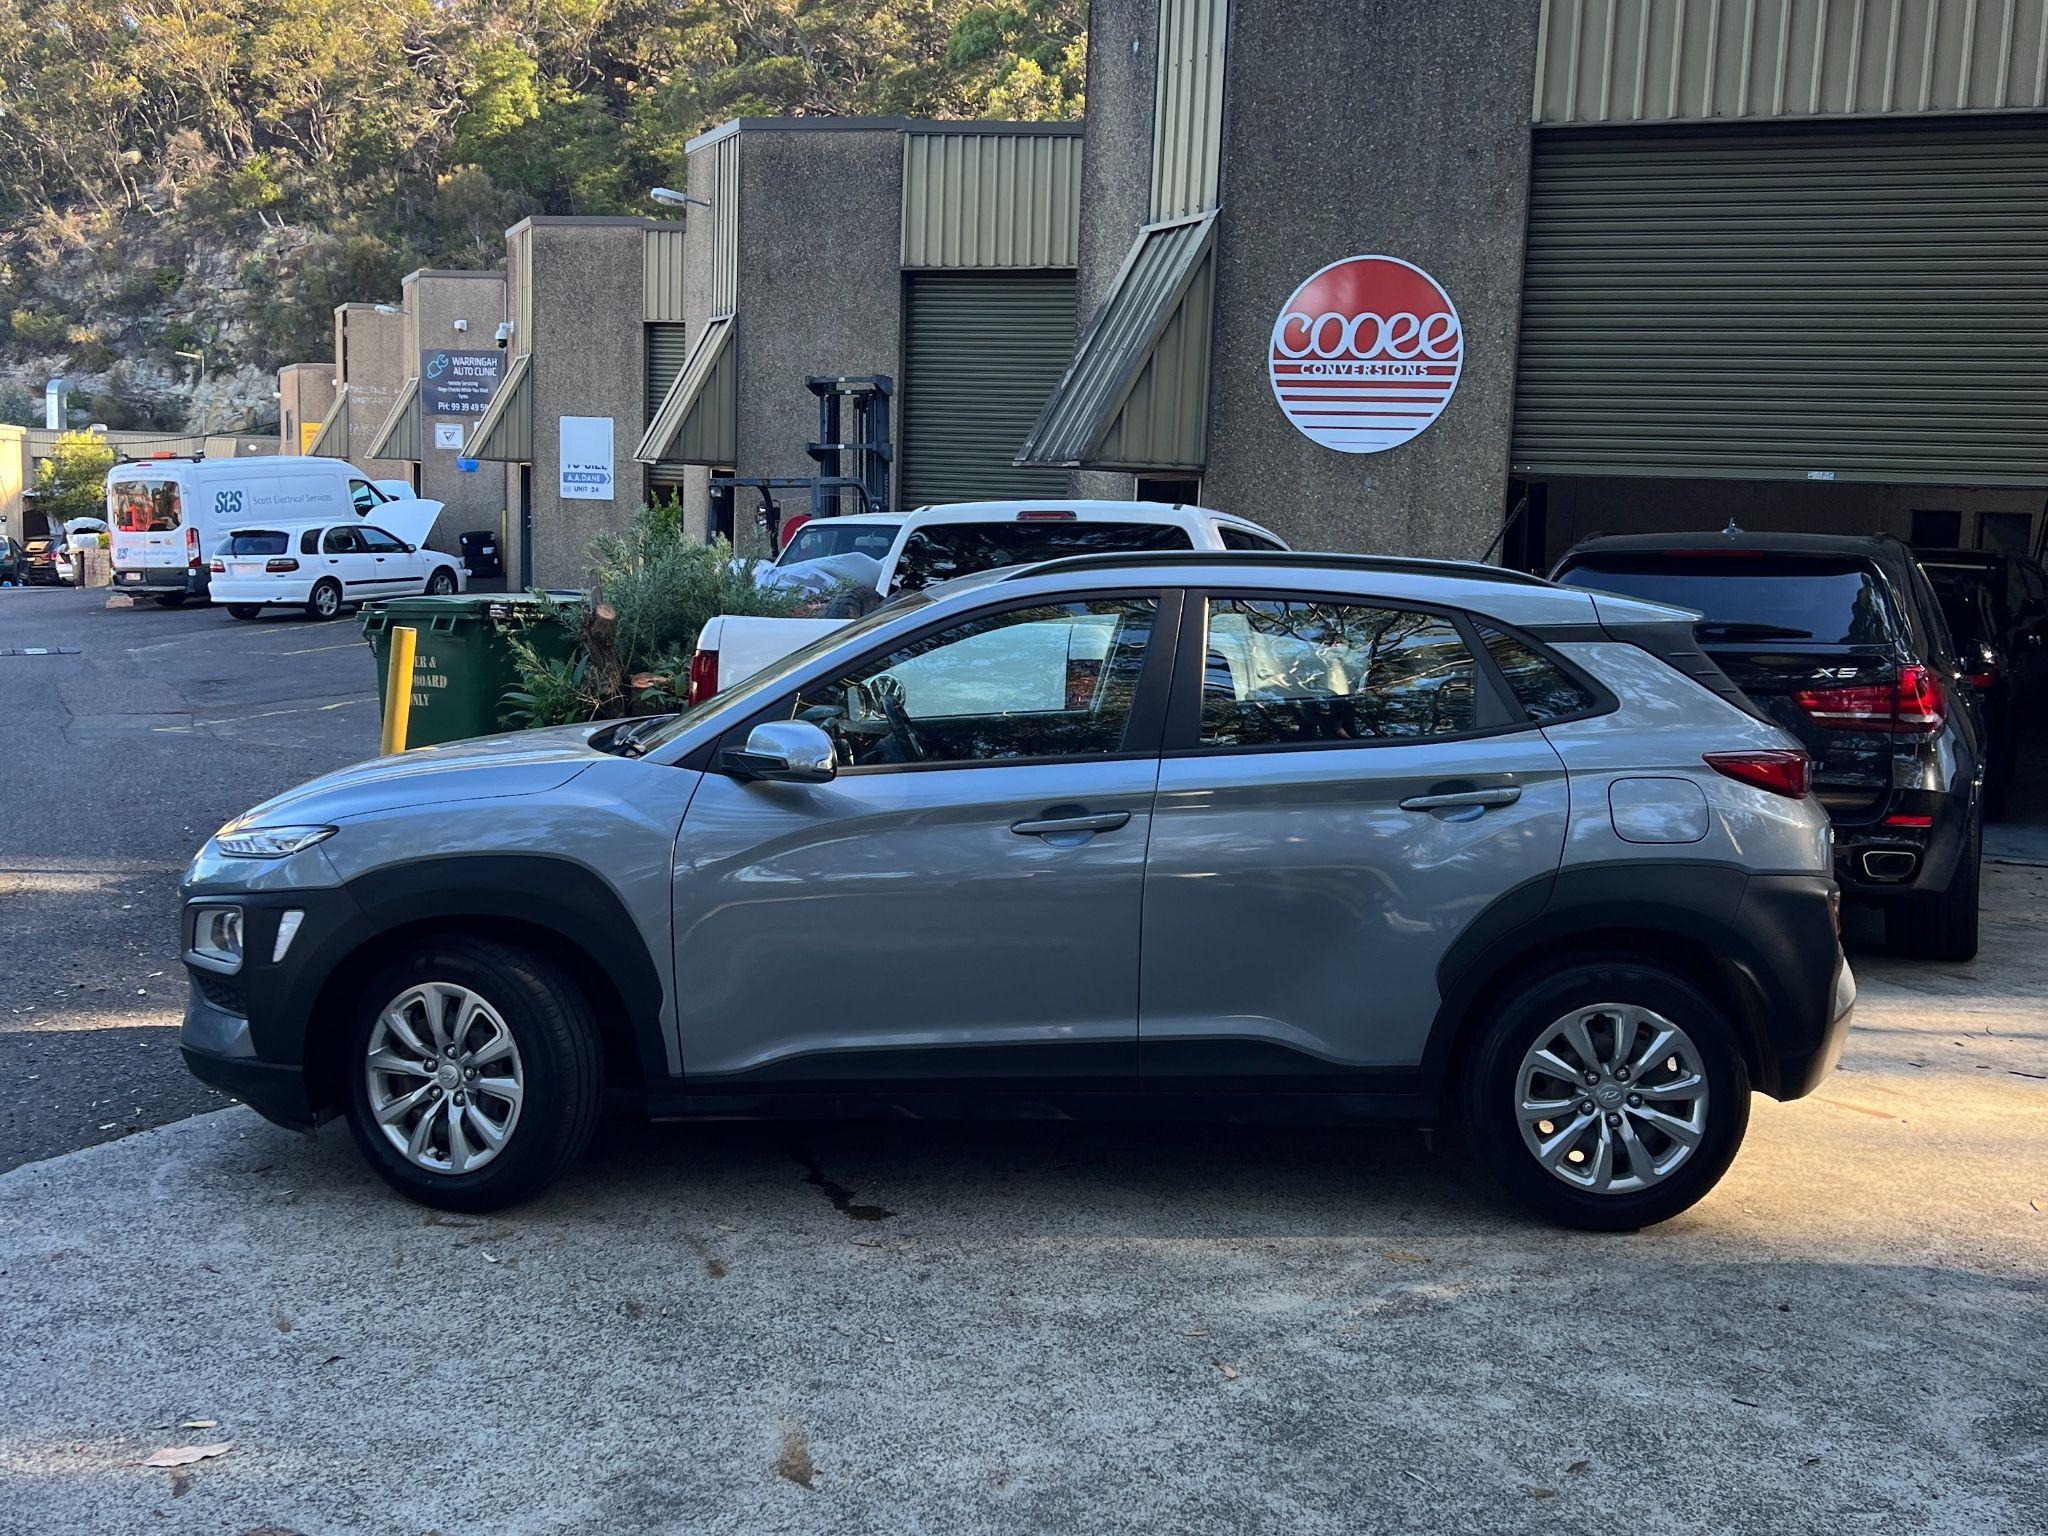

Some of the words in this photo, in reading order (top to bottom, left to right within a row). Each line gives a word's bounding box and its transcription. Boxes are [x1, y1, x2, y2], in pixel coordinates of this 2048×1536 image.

[1275, 312, 1459, 360] cooee
[452, 357, 498, 366] WARRINGAH
[453, 367, 474, 376] AUTO
[474, 368, 497, 376] CLINIC
[1301, 364, 1428, 376] CONVERSIONS
[450, 402, 460, 411] 99
[461, 403, 470, 411] 39
[470, 403, 479, 411] 49
[253, 496, 272, 505] Scott
[273, 495, 304, 505] Electrical
[306, 494, 333, 502] Services
[429, 656, 437, 668] &
[1811, 668, 1858, 679] X5
[414, 674, 448, 688] BOARD
[411, 694, 429, 706] NLY
